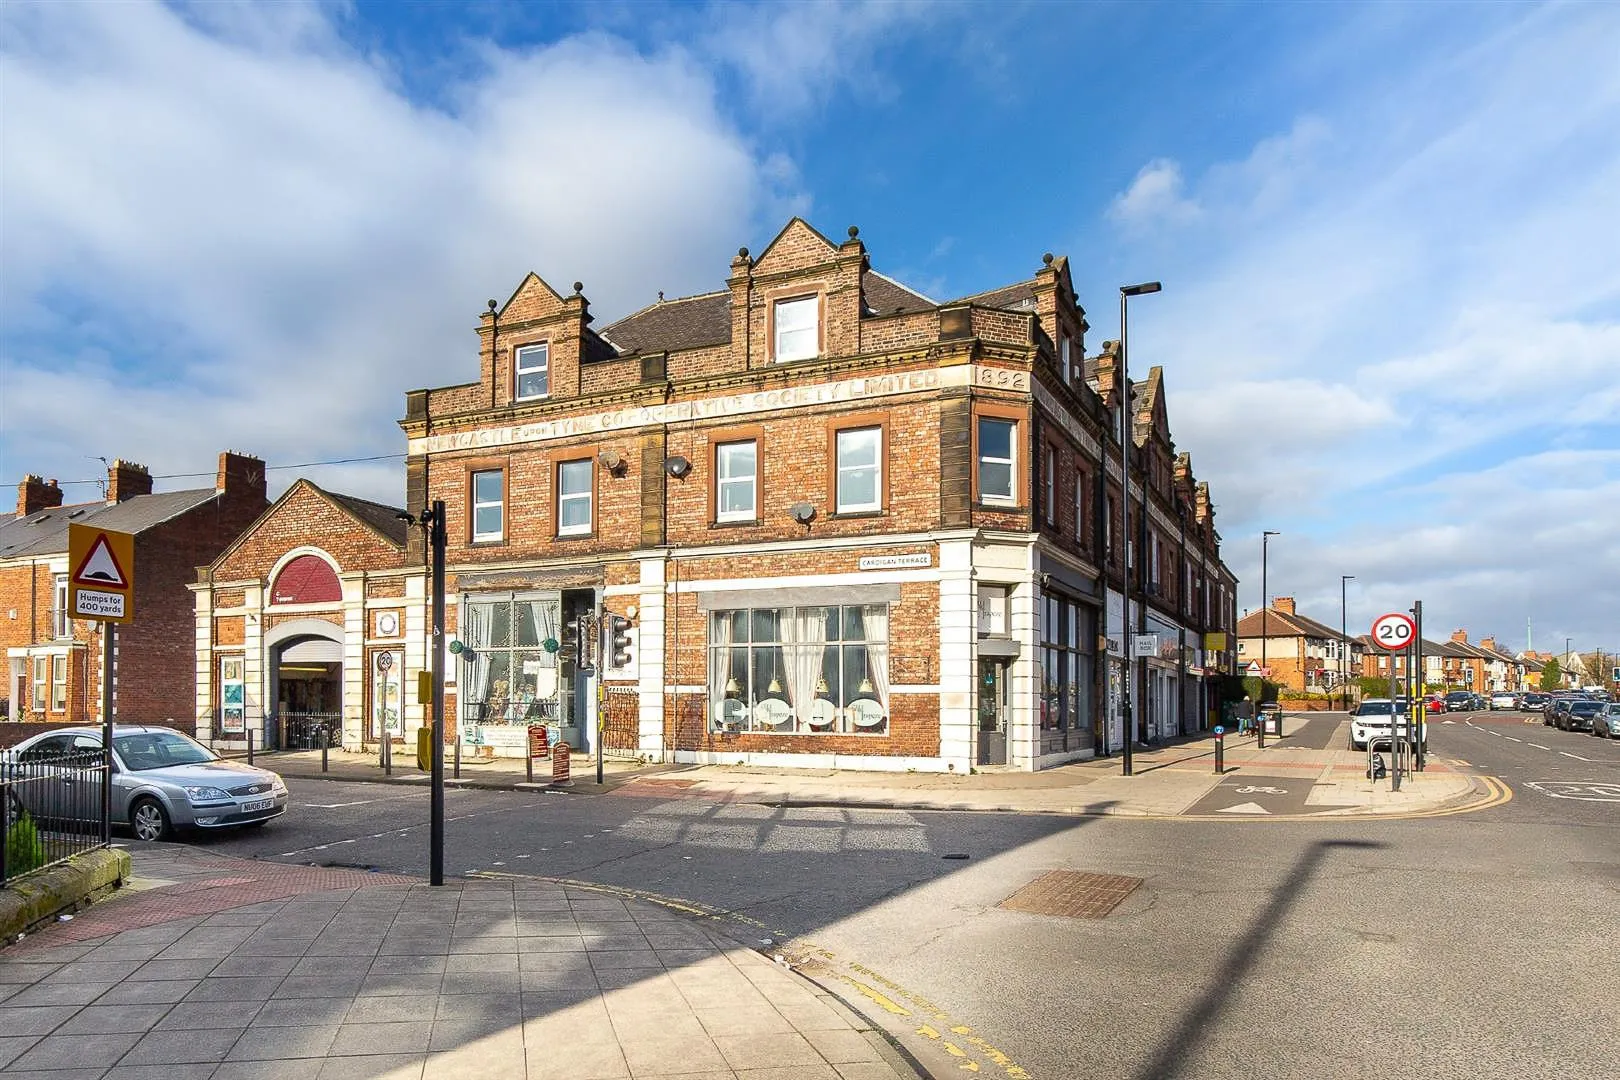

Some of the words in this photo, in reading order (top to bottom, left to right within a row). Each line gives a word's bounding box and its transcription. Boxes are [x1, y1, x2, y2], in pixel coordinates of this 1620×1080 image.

[426, 428, 520, 452] NEWCASTLE
[551, 416, 594, 437] TYNE
[751, 382, 840, 406] SOCIETY
[849, 370, 939, 397] LIMITED
[898, 557, 928, 565] TERRACE
[80, 593, 108, 604] Humps
[110, 597, 121, 605] for
[80, 602, 98, 611] 400
[100, 605, 121, 613] yards
[1380, 624, 1410, 639] 20
[381, 656, 391, 665] 20
